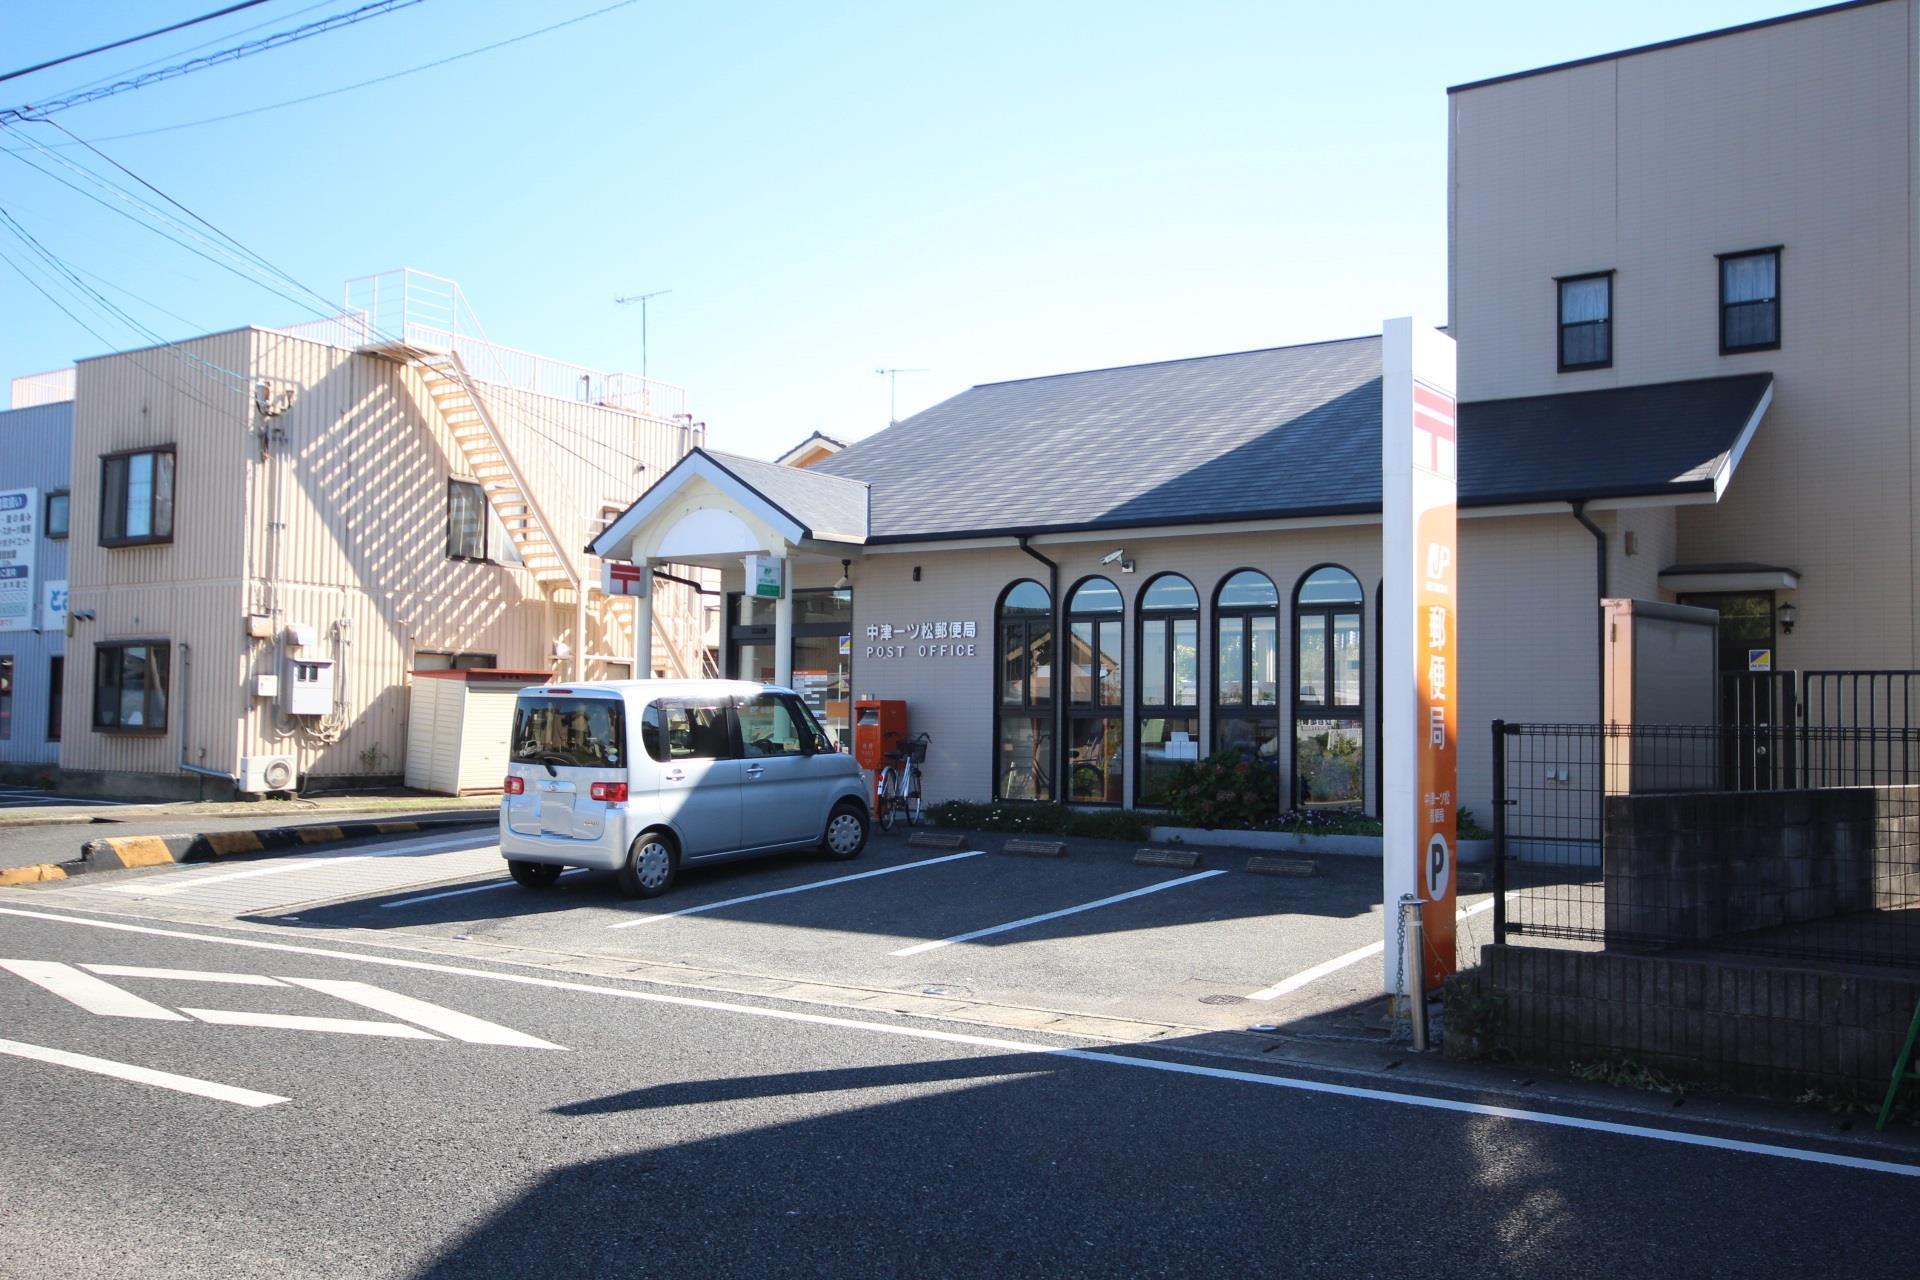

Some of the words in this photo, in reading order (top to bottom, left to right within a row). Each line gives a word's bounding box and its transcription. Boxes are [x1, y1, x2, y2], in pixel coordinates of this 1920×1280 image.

[866, 621, 976, 641] 中津一ツ松郵便局
[866, 645, 905, 659] POST
[918, 644, 975, 657] OFFICE
[1428, 606, 1446, 750] 郵便局
[1431, 843, 1444, 891] P
